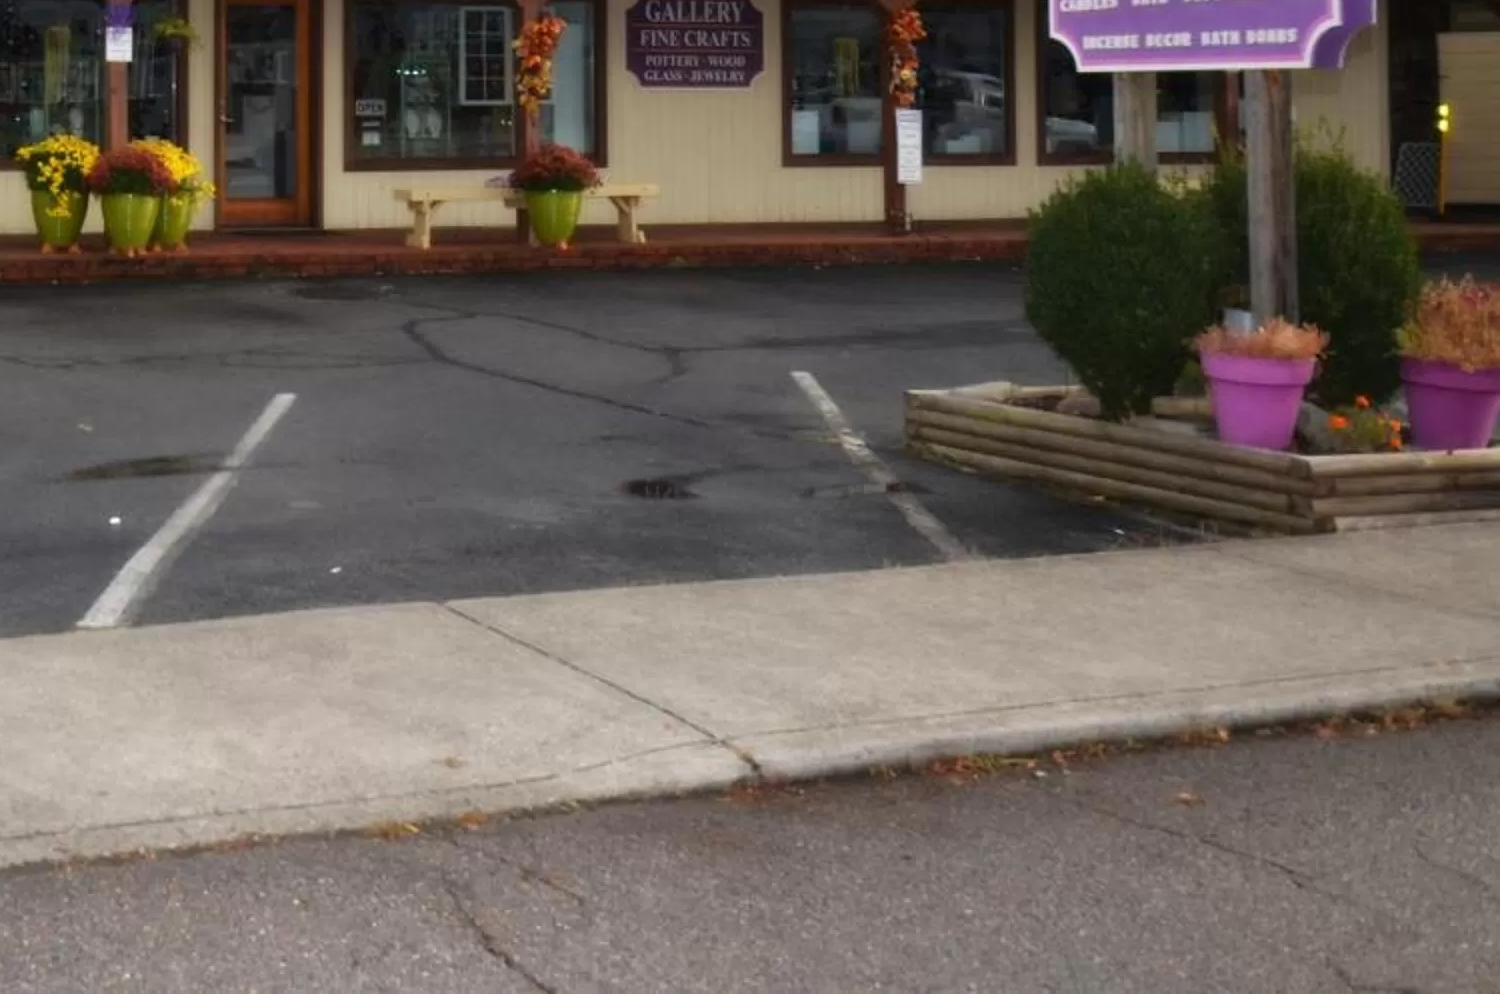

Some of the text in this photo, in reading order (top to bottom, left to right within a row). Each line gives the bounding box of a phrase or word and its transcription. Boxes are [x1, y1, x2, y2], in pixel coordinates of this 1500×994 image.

[640, 29, 751, 48] FINE CRAFTS
[1082, 27, 1298, 50] INCENSE DECOR BATH BOMBS
[645, 55, 747, 68] POTTERY WOOD
[643, 69, 746, 83] GLASS JEWELRY
